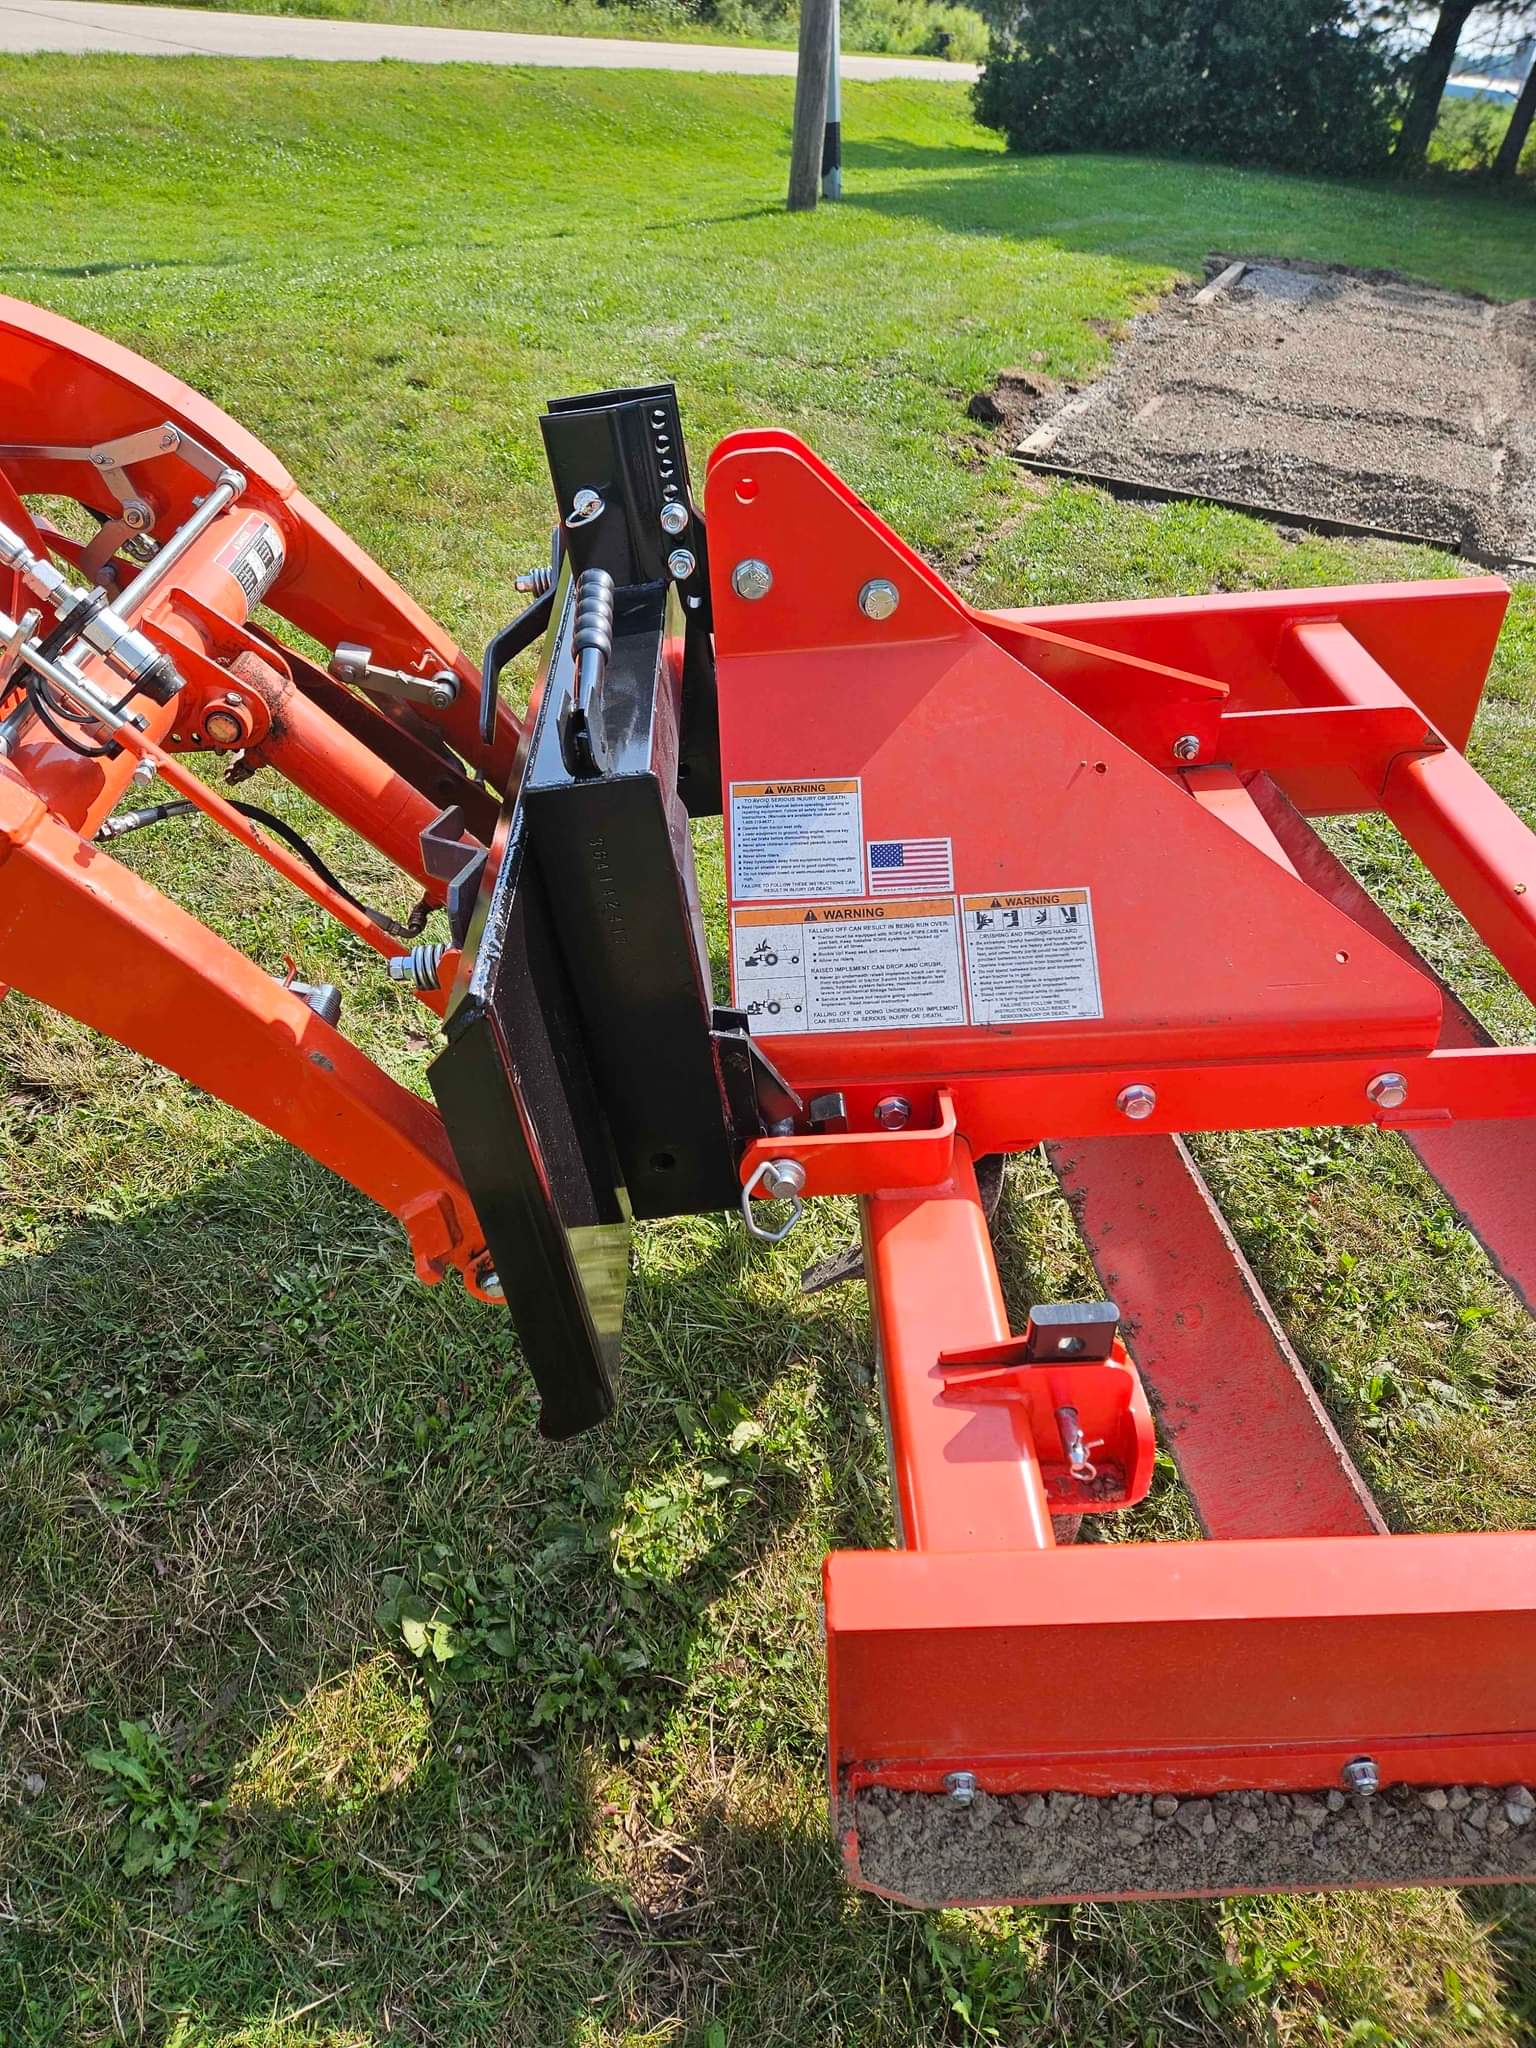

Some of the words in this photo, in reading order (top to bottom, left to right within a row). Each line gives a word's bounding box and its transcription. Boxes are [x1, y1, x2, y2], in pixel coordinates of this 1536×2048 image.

[777, 784, 825, 793] WARNING
[1005, 895, 1059, 906] WARNING
[823, 907, 884, 920] WARNING
